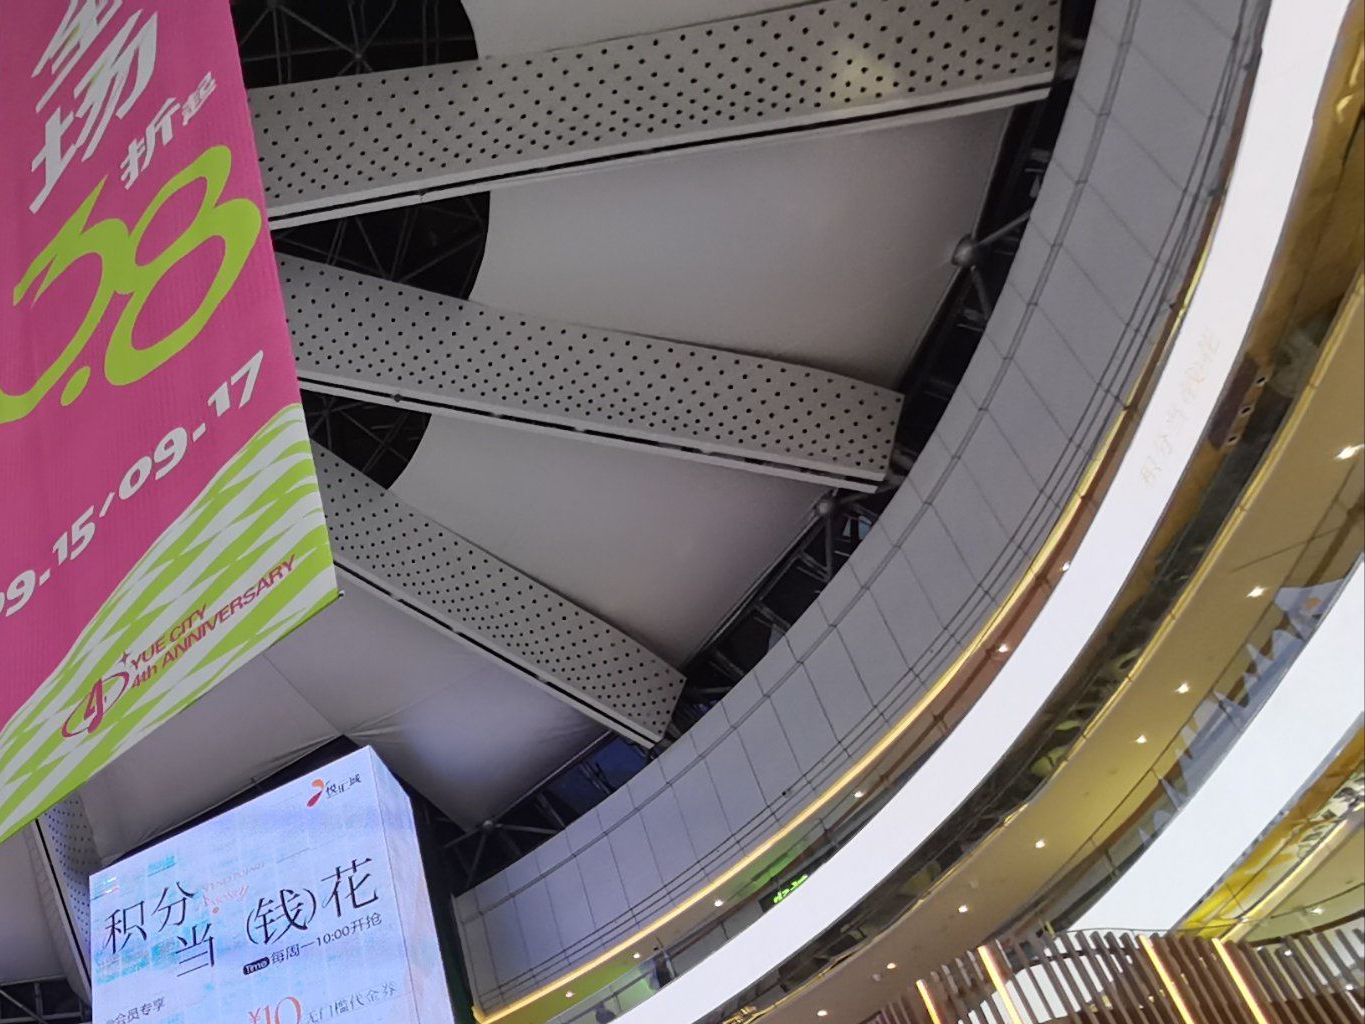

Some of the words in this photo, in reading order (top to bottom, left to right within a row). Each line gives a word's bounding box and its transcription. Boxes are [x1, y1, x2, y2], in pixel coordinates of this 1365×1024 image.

[131, 636, 166, 671] YUE
[169, 602, 207, 643] CITY
[132, 665, 158, 689] 4th
[162, 554, 295, 668] ANNIVERSARY
